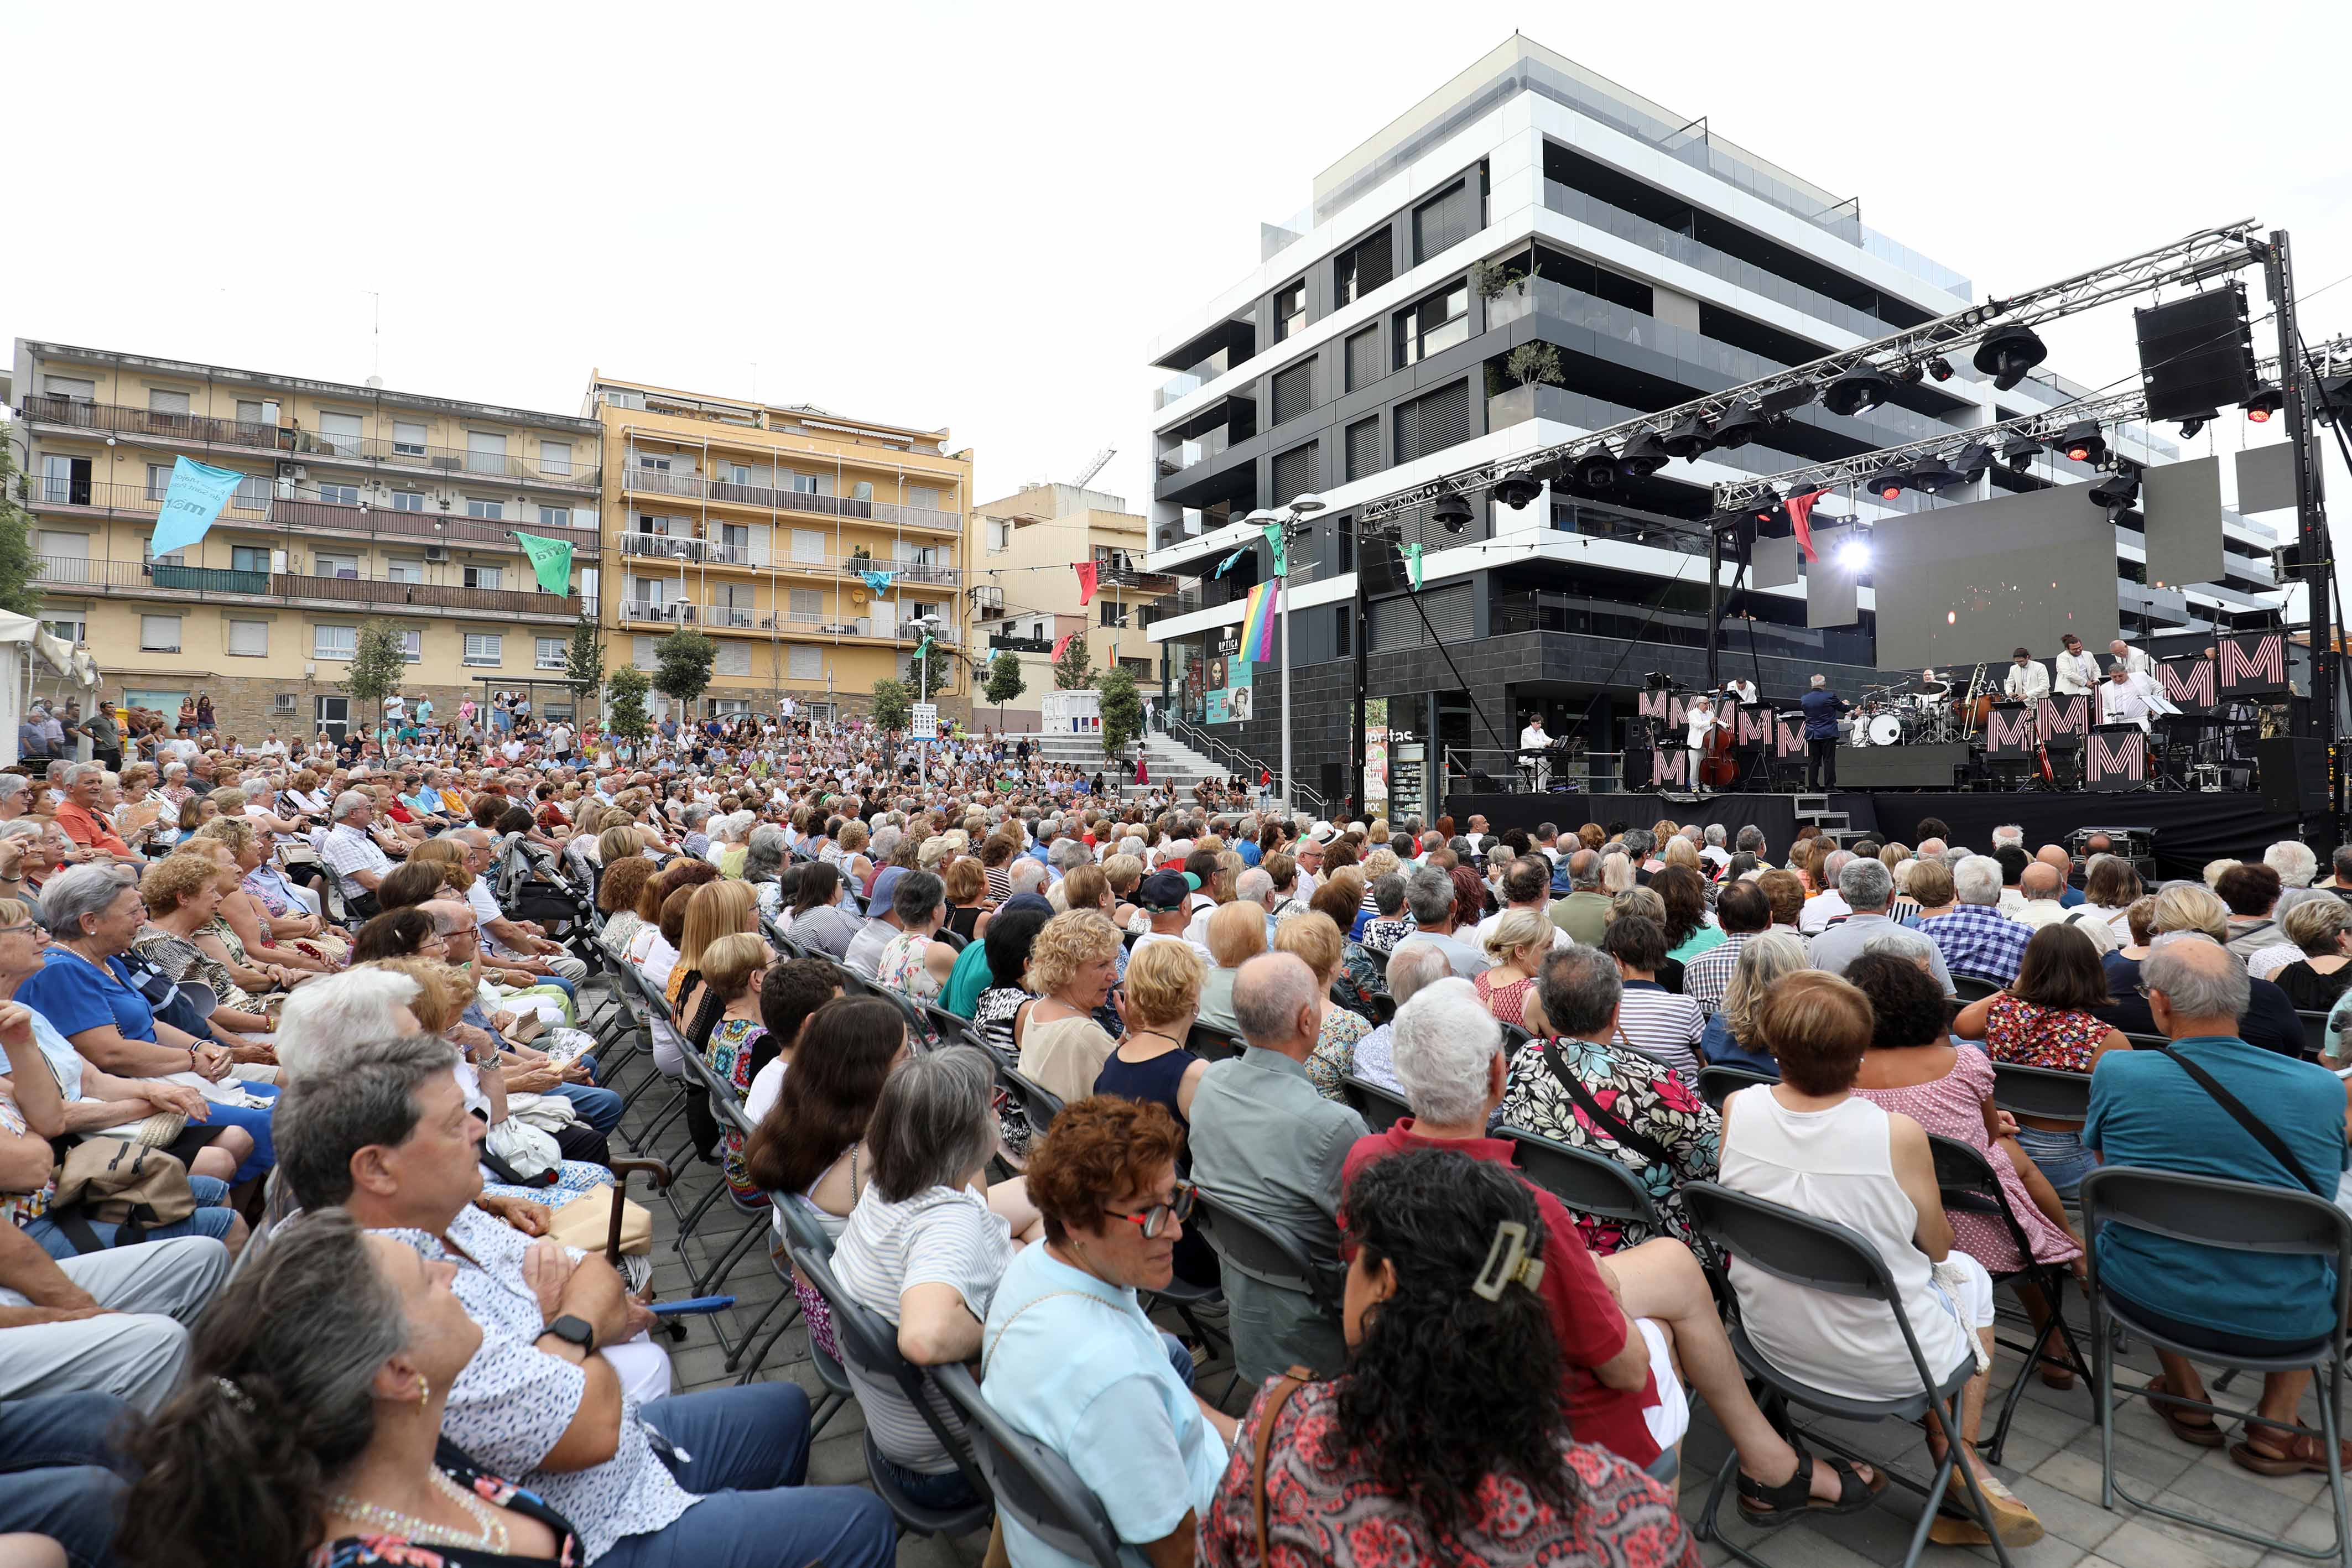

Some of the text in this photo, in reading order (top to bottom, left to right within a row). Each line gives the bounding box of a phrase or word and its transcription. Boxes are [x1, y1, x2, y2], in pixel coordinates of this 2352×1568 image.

[2219, 635, 2284, 687] M
[2156, 660, 2214, 707] M
[1739, 710, 1772, 746] M
[1987, 710, 2034, 752] M
[2038, 695, 2089, 741] M
[1653, 751, 1685, 786] M
[2087, 732, 2143, 782] M
[1364, 791, 1383, 801] ERITAS
